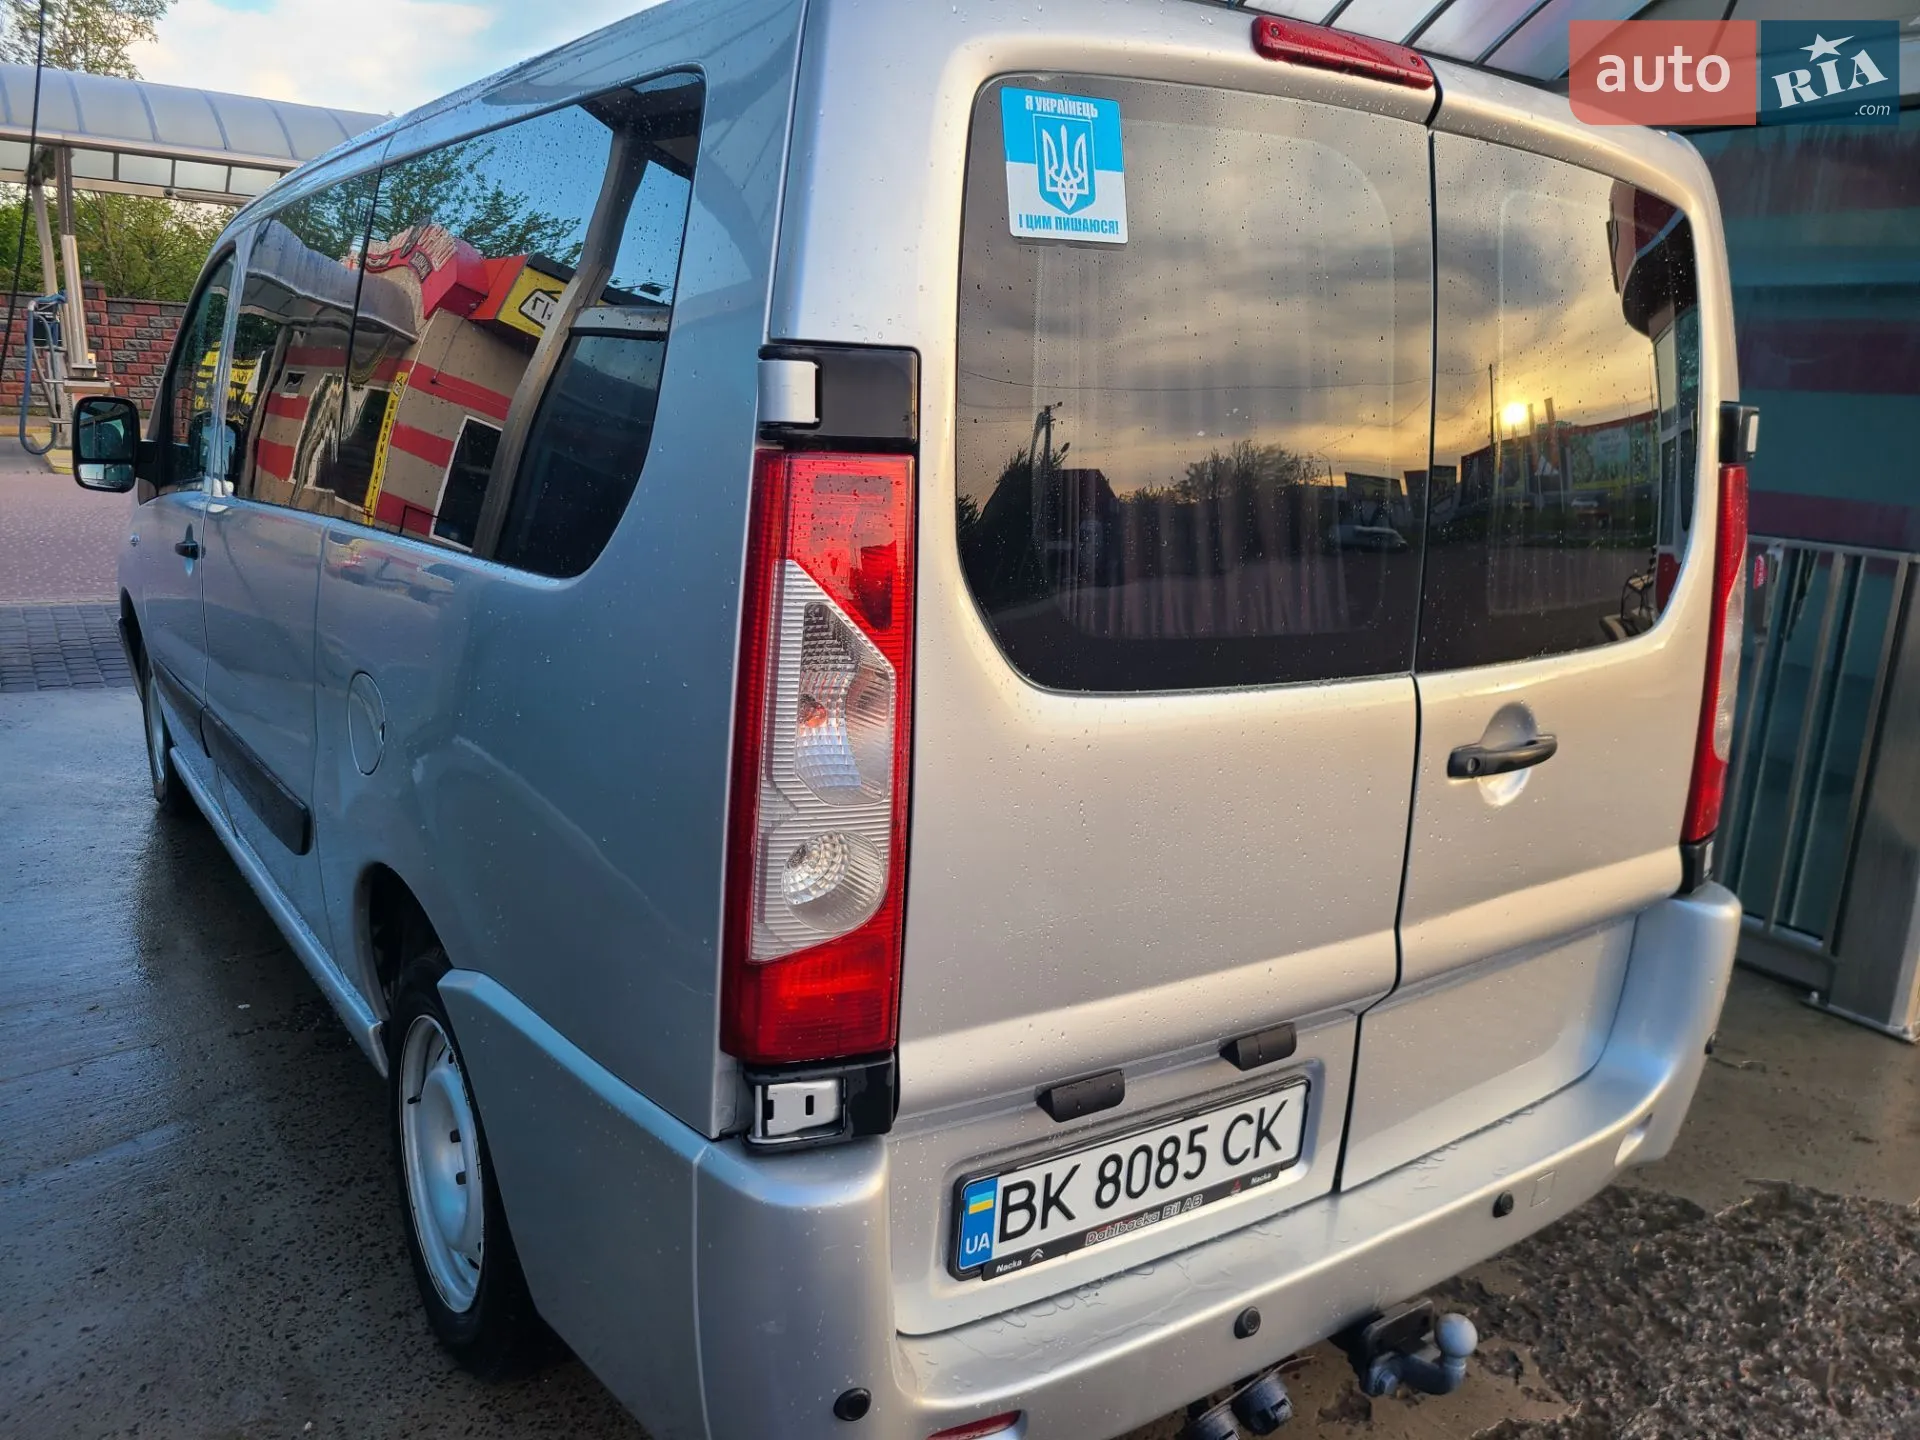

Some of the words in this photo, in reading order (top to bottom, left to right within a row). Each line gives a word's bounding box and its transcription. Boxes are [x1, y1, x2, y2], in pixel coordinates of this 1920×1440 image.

[1025, 95, 1034, 111] Я
[1035, 96, 1098, 119] УКРАЇНЕЦЬ
[1026, 214, 1052, 233] ЦИМ
[1055, 217, 1120, 235] ПИШАЮСЯ!
[999, 1163, 1081, 1244] BK
[1095, 1125, 1209, 1210] 8085
[1222, 1099, 1288, 1166] CK
[1250, 1172, 1272, 1185] Nacka
[1162, 1201, 1181, 1219] Bil
[1182, 1194, 1204, 1212] AB
[966, 1231, 990, 1255] UA
[996, 1259, 1022, 1273] Nacka
